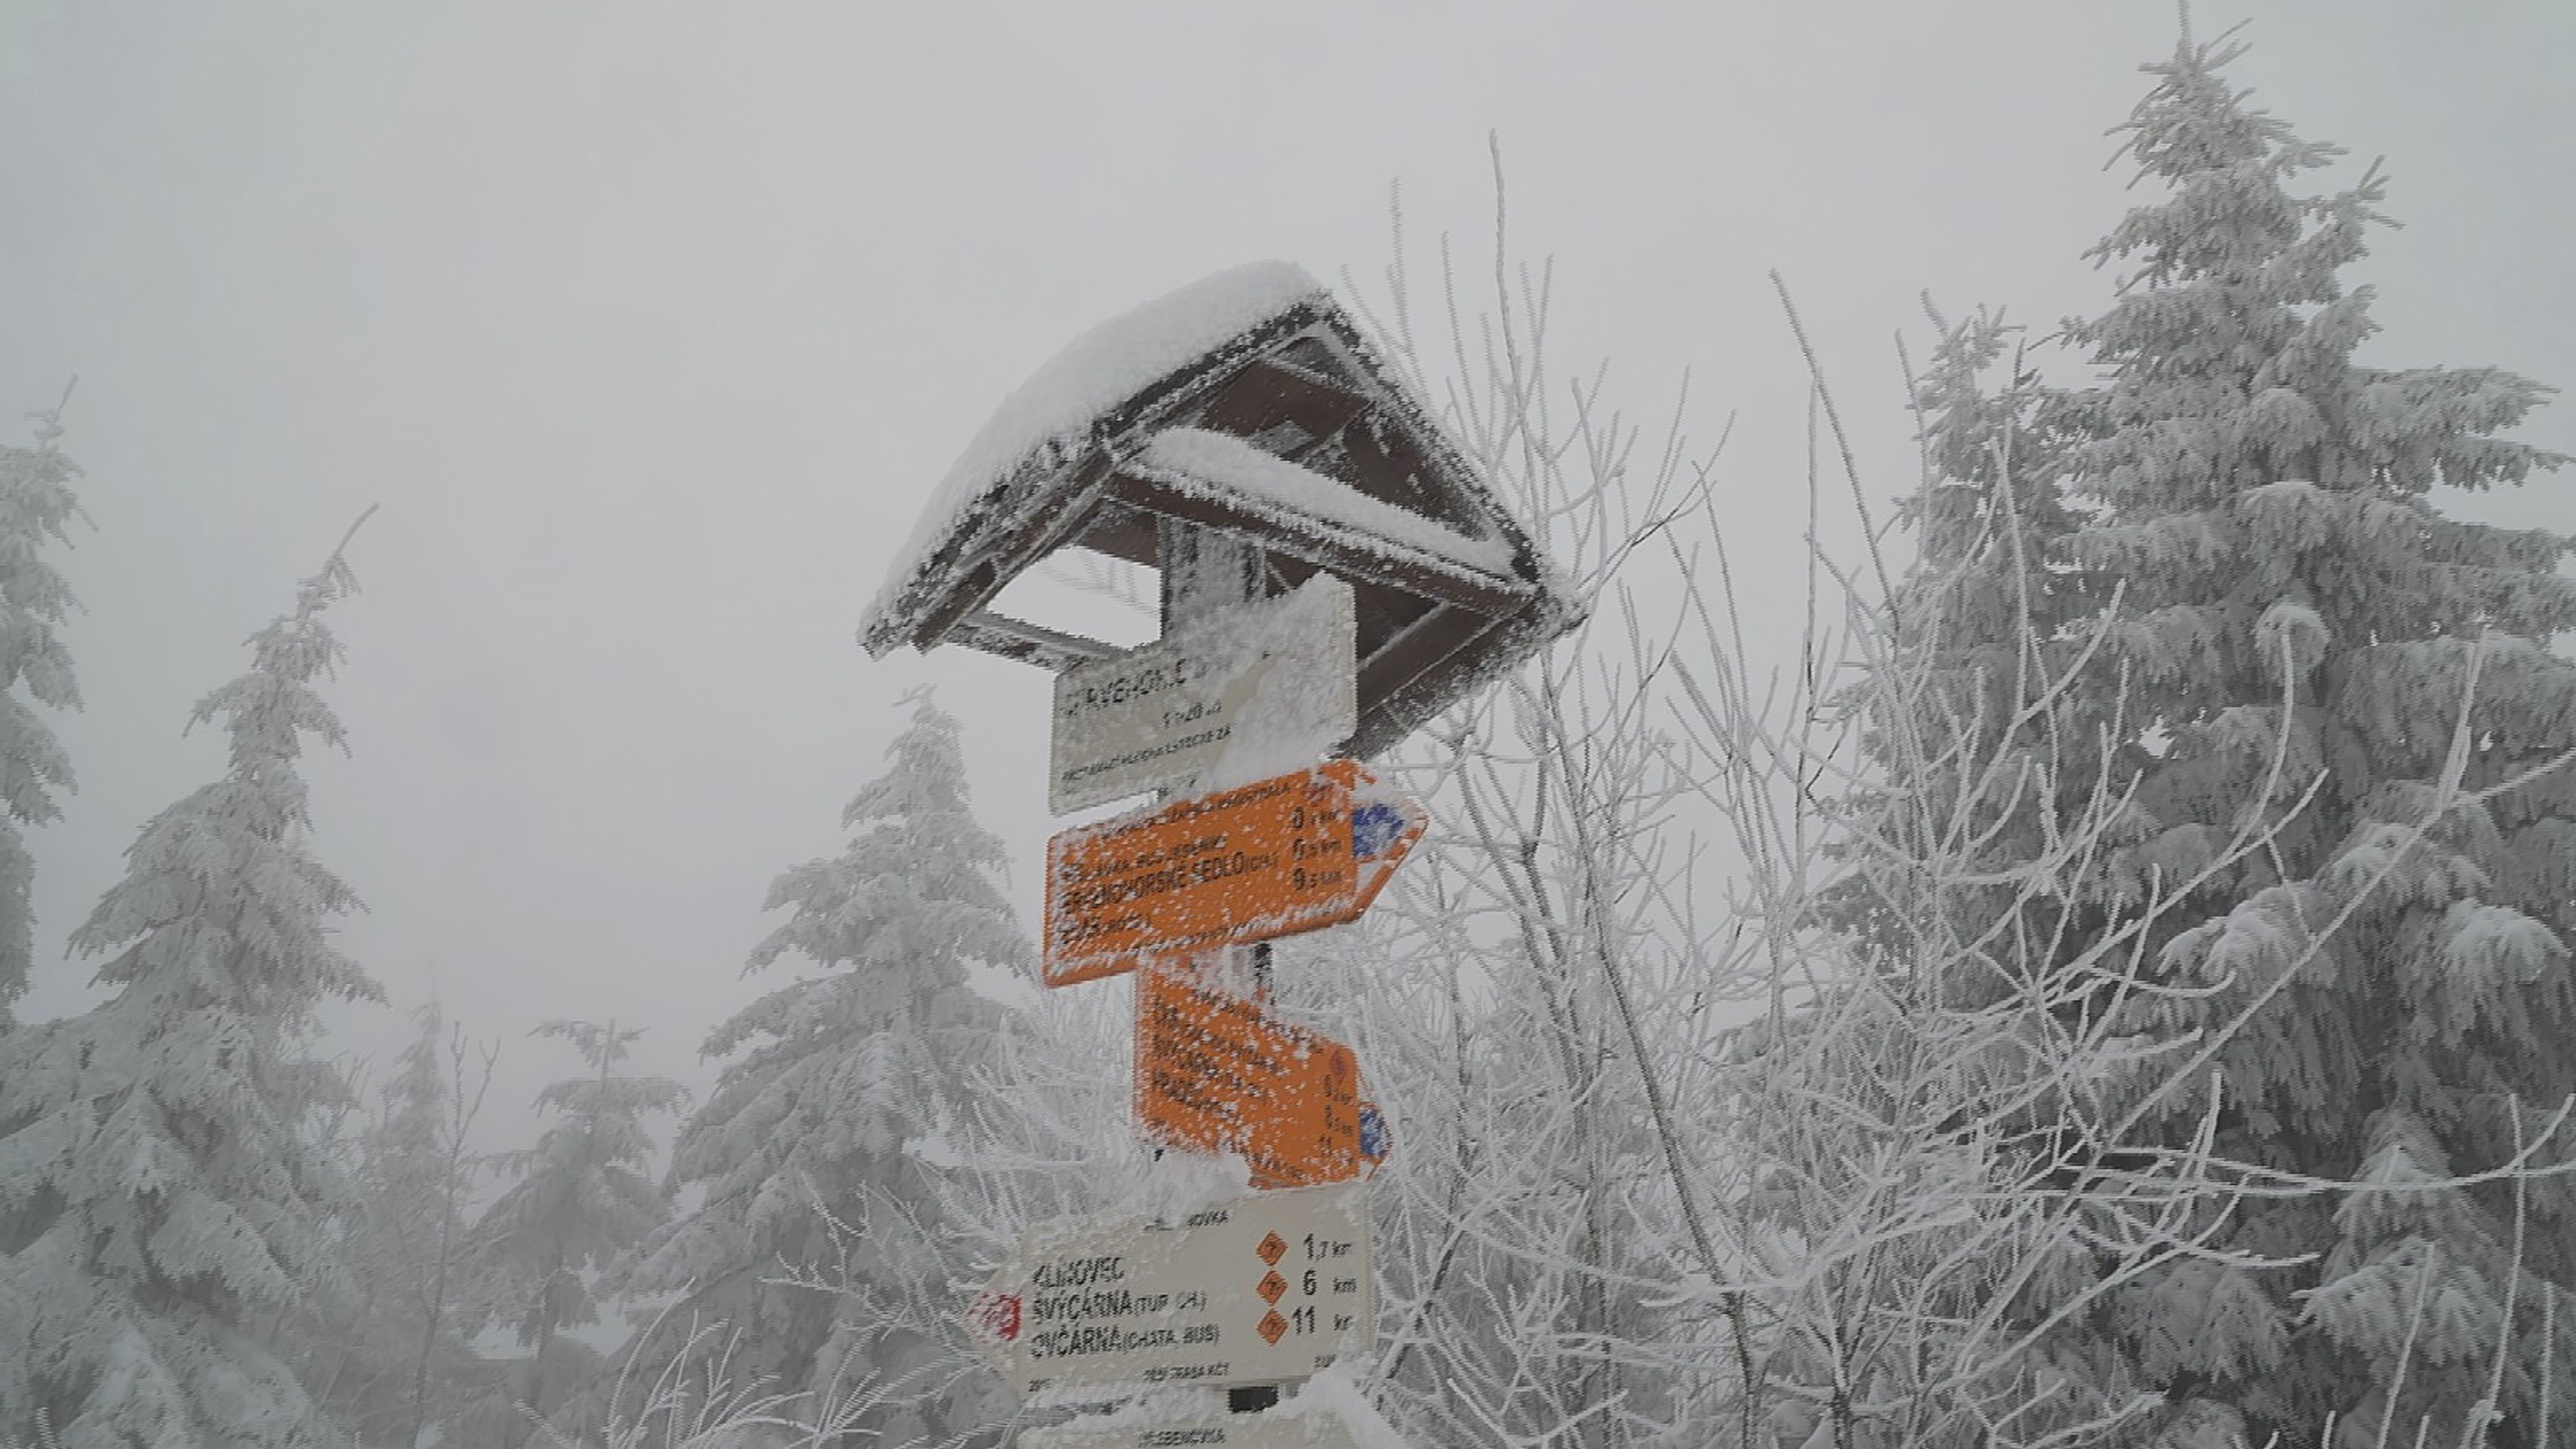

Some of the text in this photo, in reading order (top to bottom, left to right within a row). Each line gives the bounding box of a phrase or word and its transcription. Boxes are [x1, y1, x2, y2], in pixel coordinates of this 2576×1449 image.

[1303, 1269, 1358, 1297] 6 km
[1291, 1306, 1316, 1335] 11
